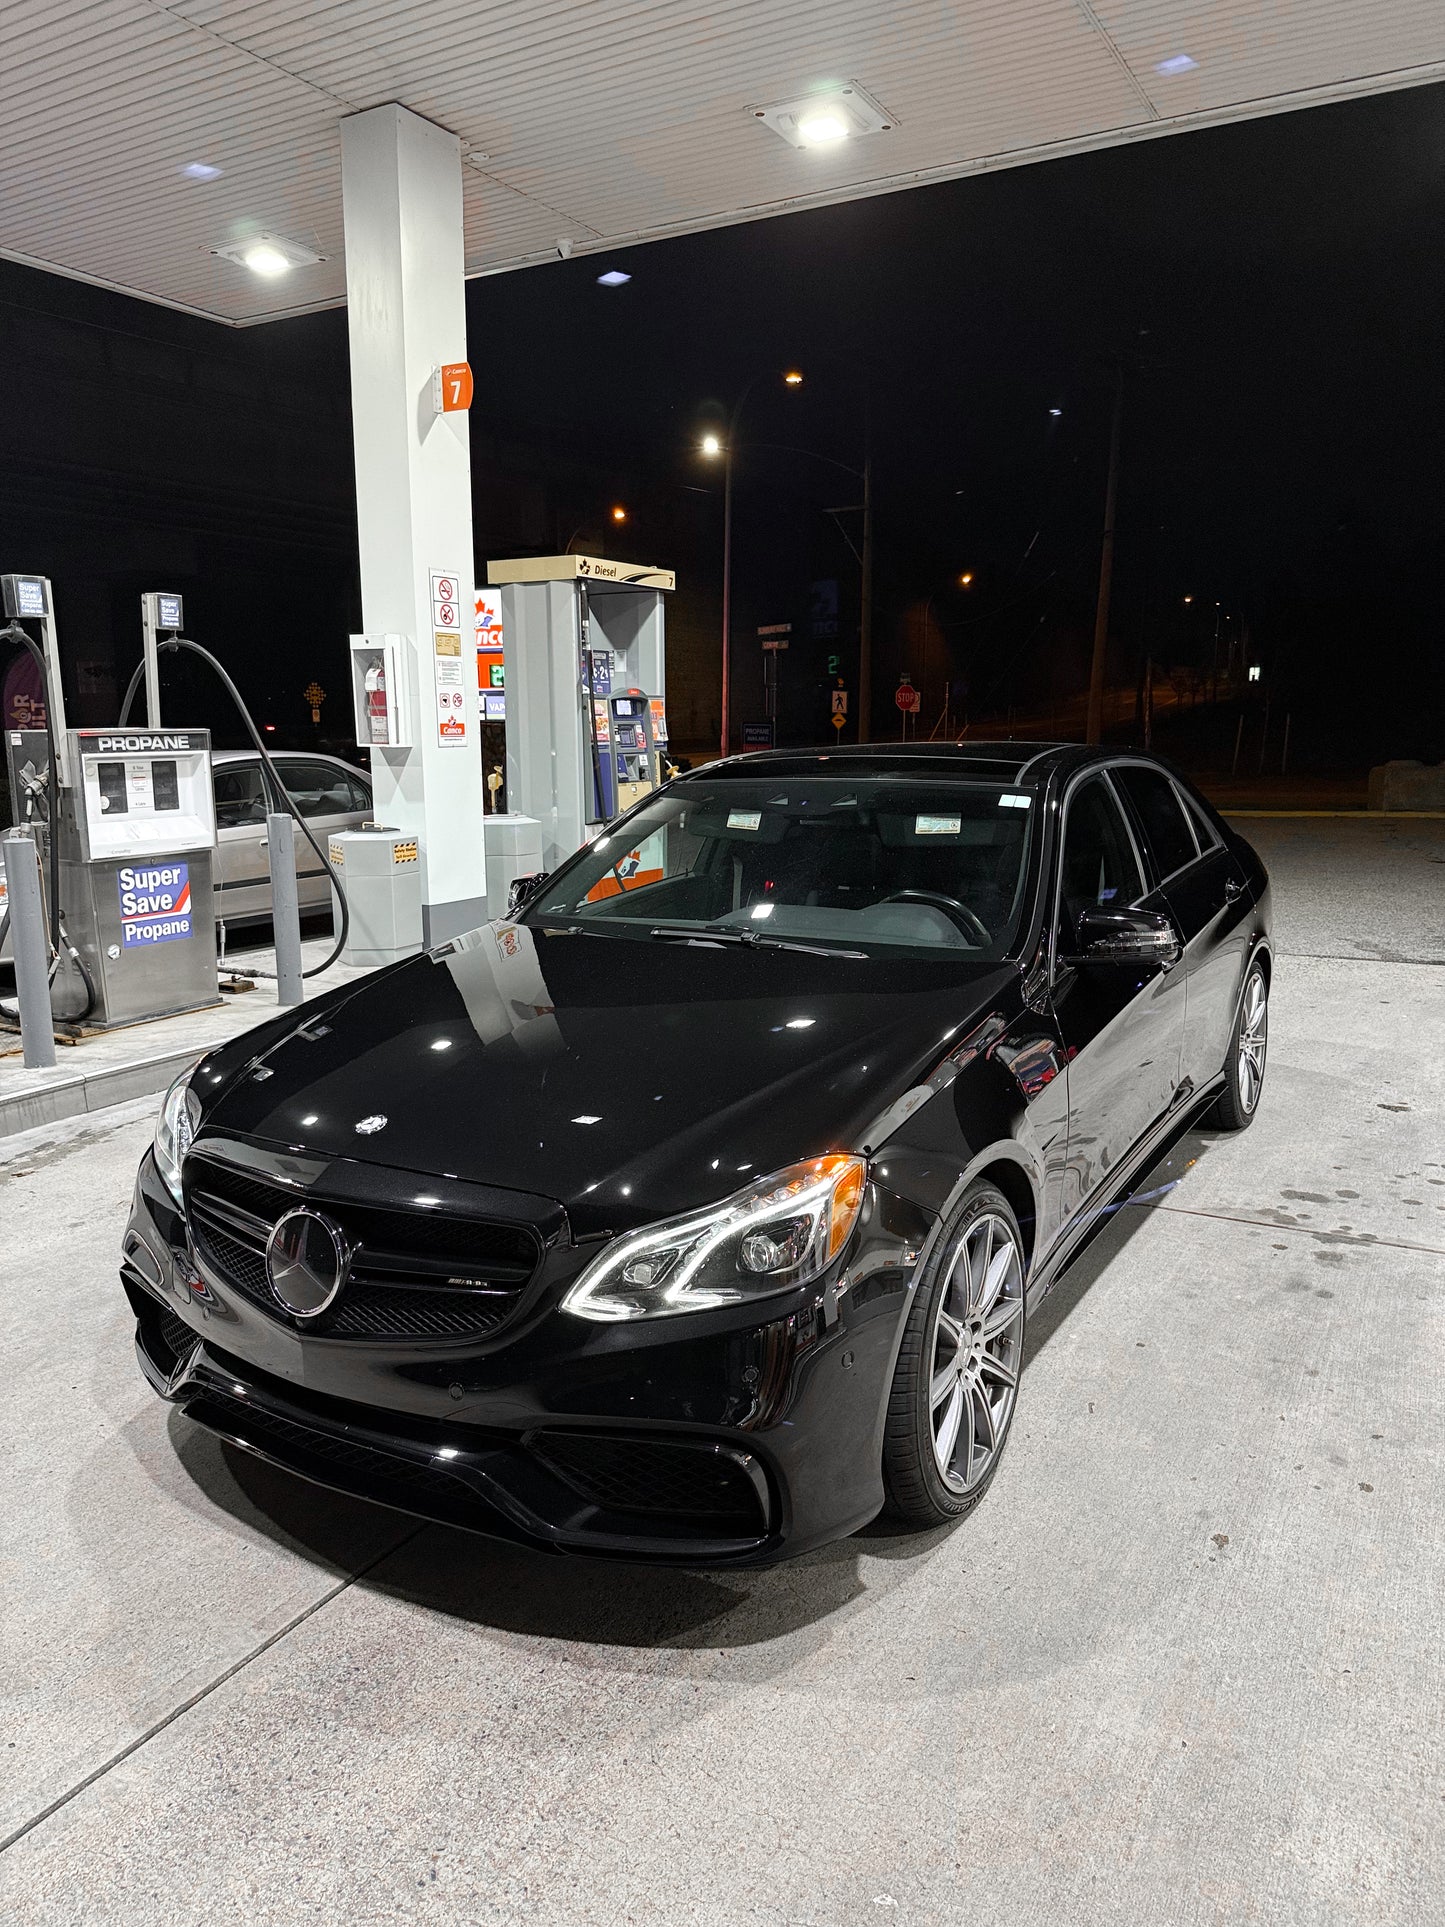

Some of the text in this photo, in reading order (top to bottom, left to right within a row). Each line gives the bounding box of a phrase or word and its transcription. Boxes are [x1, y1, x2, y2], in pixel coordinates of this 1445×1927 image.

[450, 380, 461, 405] 7
[594, 564, 675, 588] Diesel 7
[18, 583, 41, 593] Super
[20, 592, 38, 600] Save
[161, 600, 178, 608] Super
[898, 694, 914, 703] STOP
[488, 703, 506, 712] VAP
[443, 727, 463, 735] Canco
[98, 736, 190, 751] PROPANE
[120, 868, 181, 893] Super
[122, 893, 173, 916] Save
[125, 920, 190, 942] Propane
